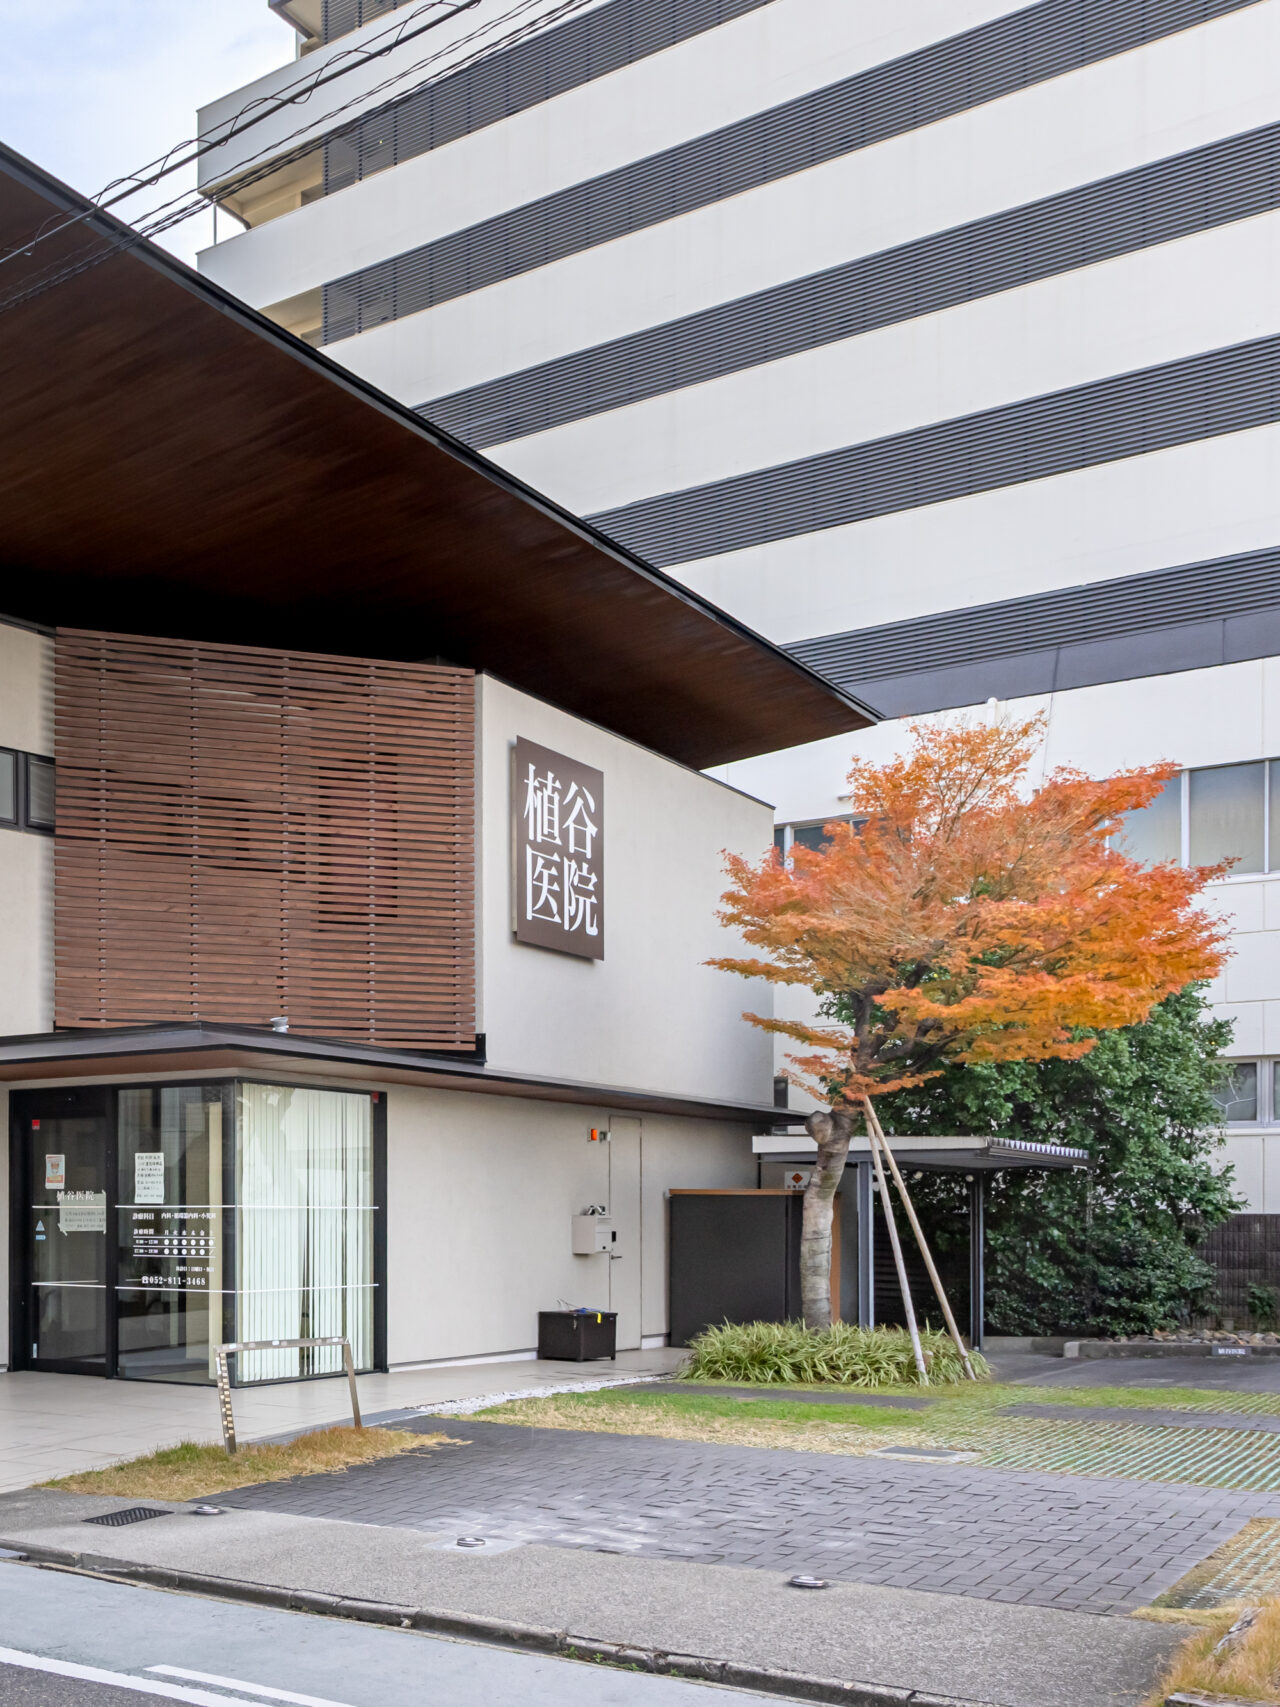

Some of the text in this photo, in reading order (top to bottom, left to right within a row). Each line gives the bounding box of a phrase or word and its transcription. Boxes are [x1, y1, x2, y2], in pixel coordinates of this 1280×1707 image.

[523, 762, 598, 859] 植谷
[526, 843, 599, 936] 医院
[149, 1276, 206, 1286] 052-811-3468
